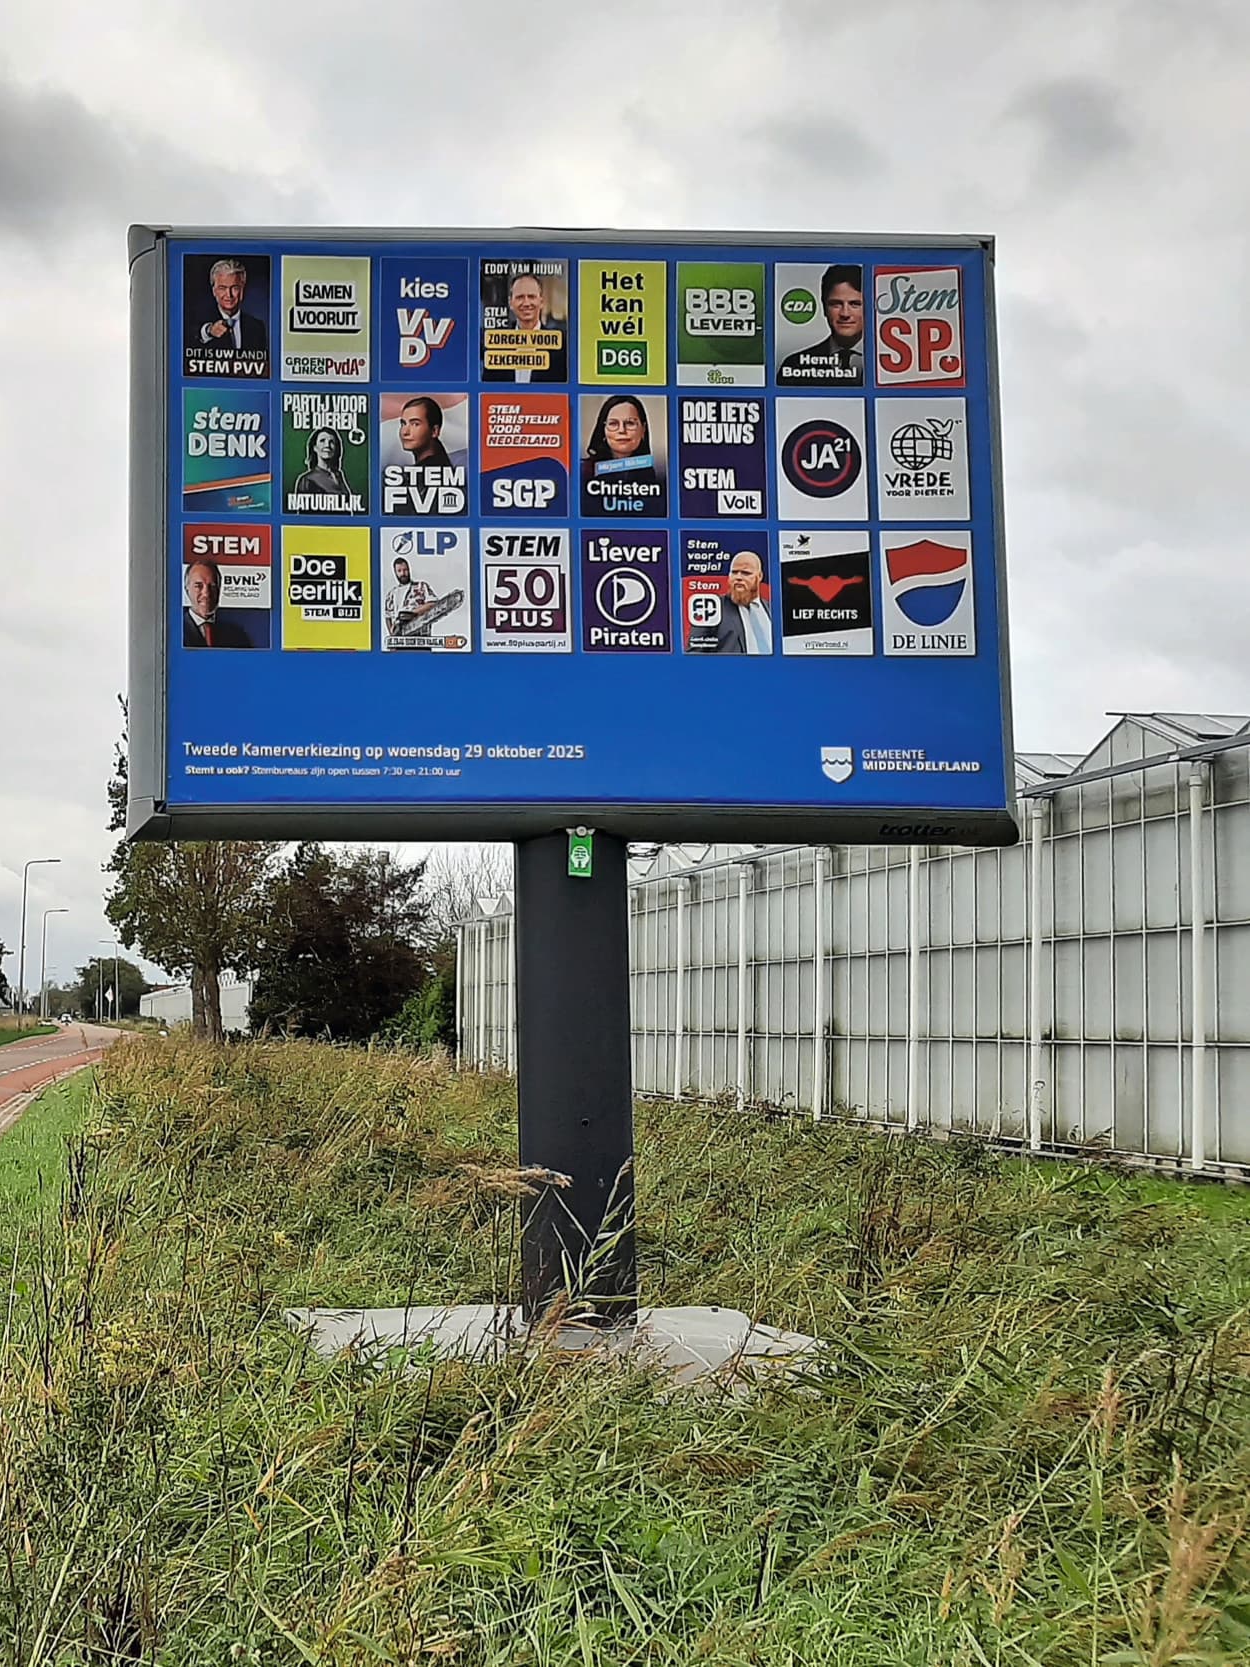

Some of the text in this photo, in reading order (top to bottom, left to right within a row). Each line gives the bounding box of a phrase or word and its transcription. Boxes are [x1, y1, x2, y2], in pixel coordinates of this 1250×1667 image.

[484, 263, 509, 275] EDDY
[511, 263, 530, 275] VAN
[400, 277, 449, 298] kies
[601, 271, 644, 290] Het
[302, 284, 352, 299] SAMEN
[877, 276, 959, 315] Stem
[601, 294, 644, 313] kan
[685, 288, 756, 315] BBB
[783, 301, 814, 312] CDA
[297, 311, 358, 325] VOORUIT
[601, 315, 644, 335] wél
[488, 334, 559, 346] ZORGEN VOOR
[185, 348, 201, 358] DIT
[205, 349, 213, 358] IS
[215, 349, 234, 359] UW
[488, 354, 546, 366] ZEKERHEID!
[601, 349, 642, 366] D66
[800, 353, 839, 365] Henri
[189, 359, 265, 375] STEM PVV
[285, 357, 359, 375] GROEN PvdA
[292, 365, 325, 375] LINKS
[782, 366, 857, 378] Bontenbal
[283, 394, 368, 413] PARTIJ VOOR
[488, 405, 520, 414] STEM
[193, 406, 261, 431] stem
[488, 415, 561, 424] CHRISTELIJK
[682, 401, 760, 423] DOE IETS
[293, 412, 358, 430] DE DIEREN
[489, 425, 522, 434] VOOR
[682, 423, 754, 444] NIEUWS
[188, 432, 266, 457] DENK
[488, 436, 559, 445] NEDERLAND
[384, 465, 465, 486] STEM
[684, 468, 735, 490] STEM
[885, 472, 951, 487] VREDE
[492, 479, 555, 508] SGP
[586, 480, 660, 496] Christen
[384, 487, 465, 514] FVD
[603, 497, 644, 512] Unie
[723, 495, 757, 510] Volt
[192, 535, 260, 555] STEM
[417, 531, 458, 555] LP
[485, 535, 561, 557] STEM
[588, 539, 662, 562] Liever
[687, 540, 719, 549] Stem
[687, 551, 730, 560] voor de
[290, 555, 336, 576] Doe
[224, 575, 259, 585] BVNL
[493, 568, 555, 607] 50
[688, 580, 720, 590] Stem
[290, 580, 362, 606] eerlijk.
[304, 608, 330, 617] STEM
[495, 610, 554, 627] PLUS
[792, 609, 858, 620] LIEF RECHTS
[590, 627, 664, 646] Piraten
[893, 634, 967, 649] DE LINIE
[182, 742, 585, 761] Tweede Kamerverkiezing op woensdag 29 oktober 2025
[861, 748, 926, 760] GEMEENTE
[185, 765, 215, 775] Stemt
[216, 767, 224, 775] u
[225, 765, 249, 775] ook?
[251, 766, 308, 775] Stembureaus
[310, 766, 326, 777] zijn
[328, 767, 349, 777] open
[352, 767, 381, 776] tussen
[404, 768, 416, 776] en
[417, 767, 443, 776] 21:00
[445, 768, 461, 776] uur
[862, 760, 981, 772] MIDDEN-DELFLAND
